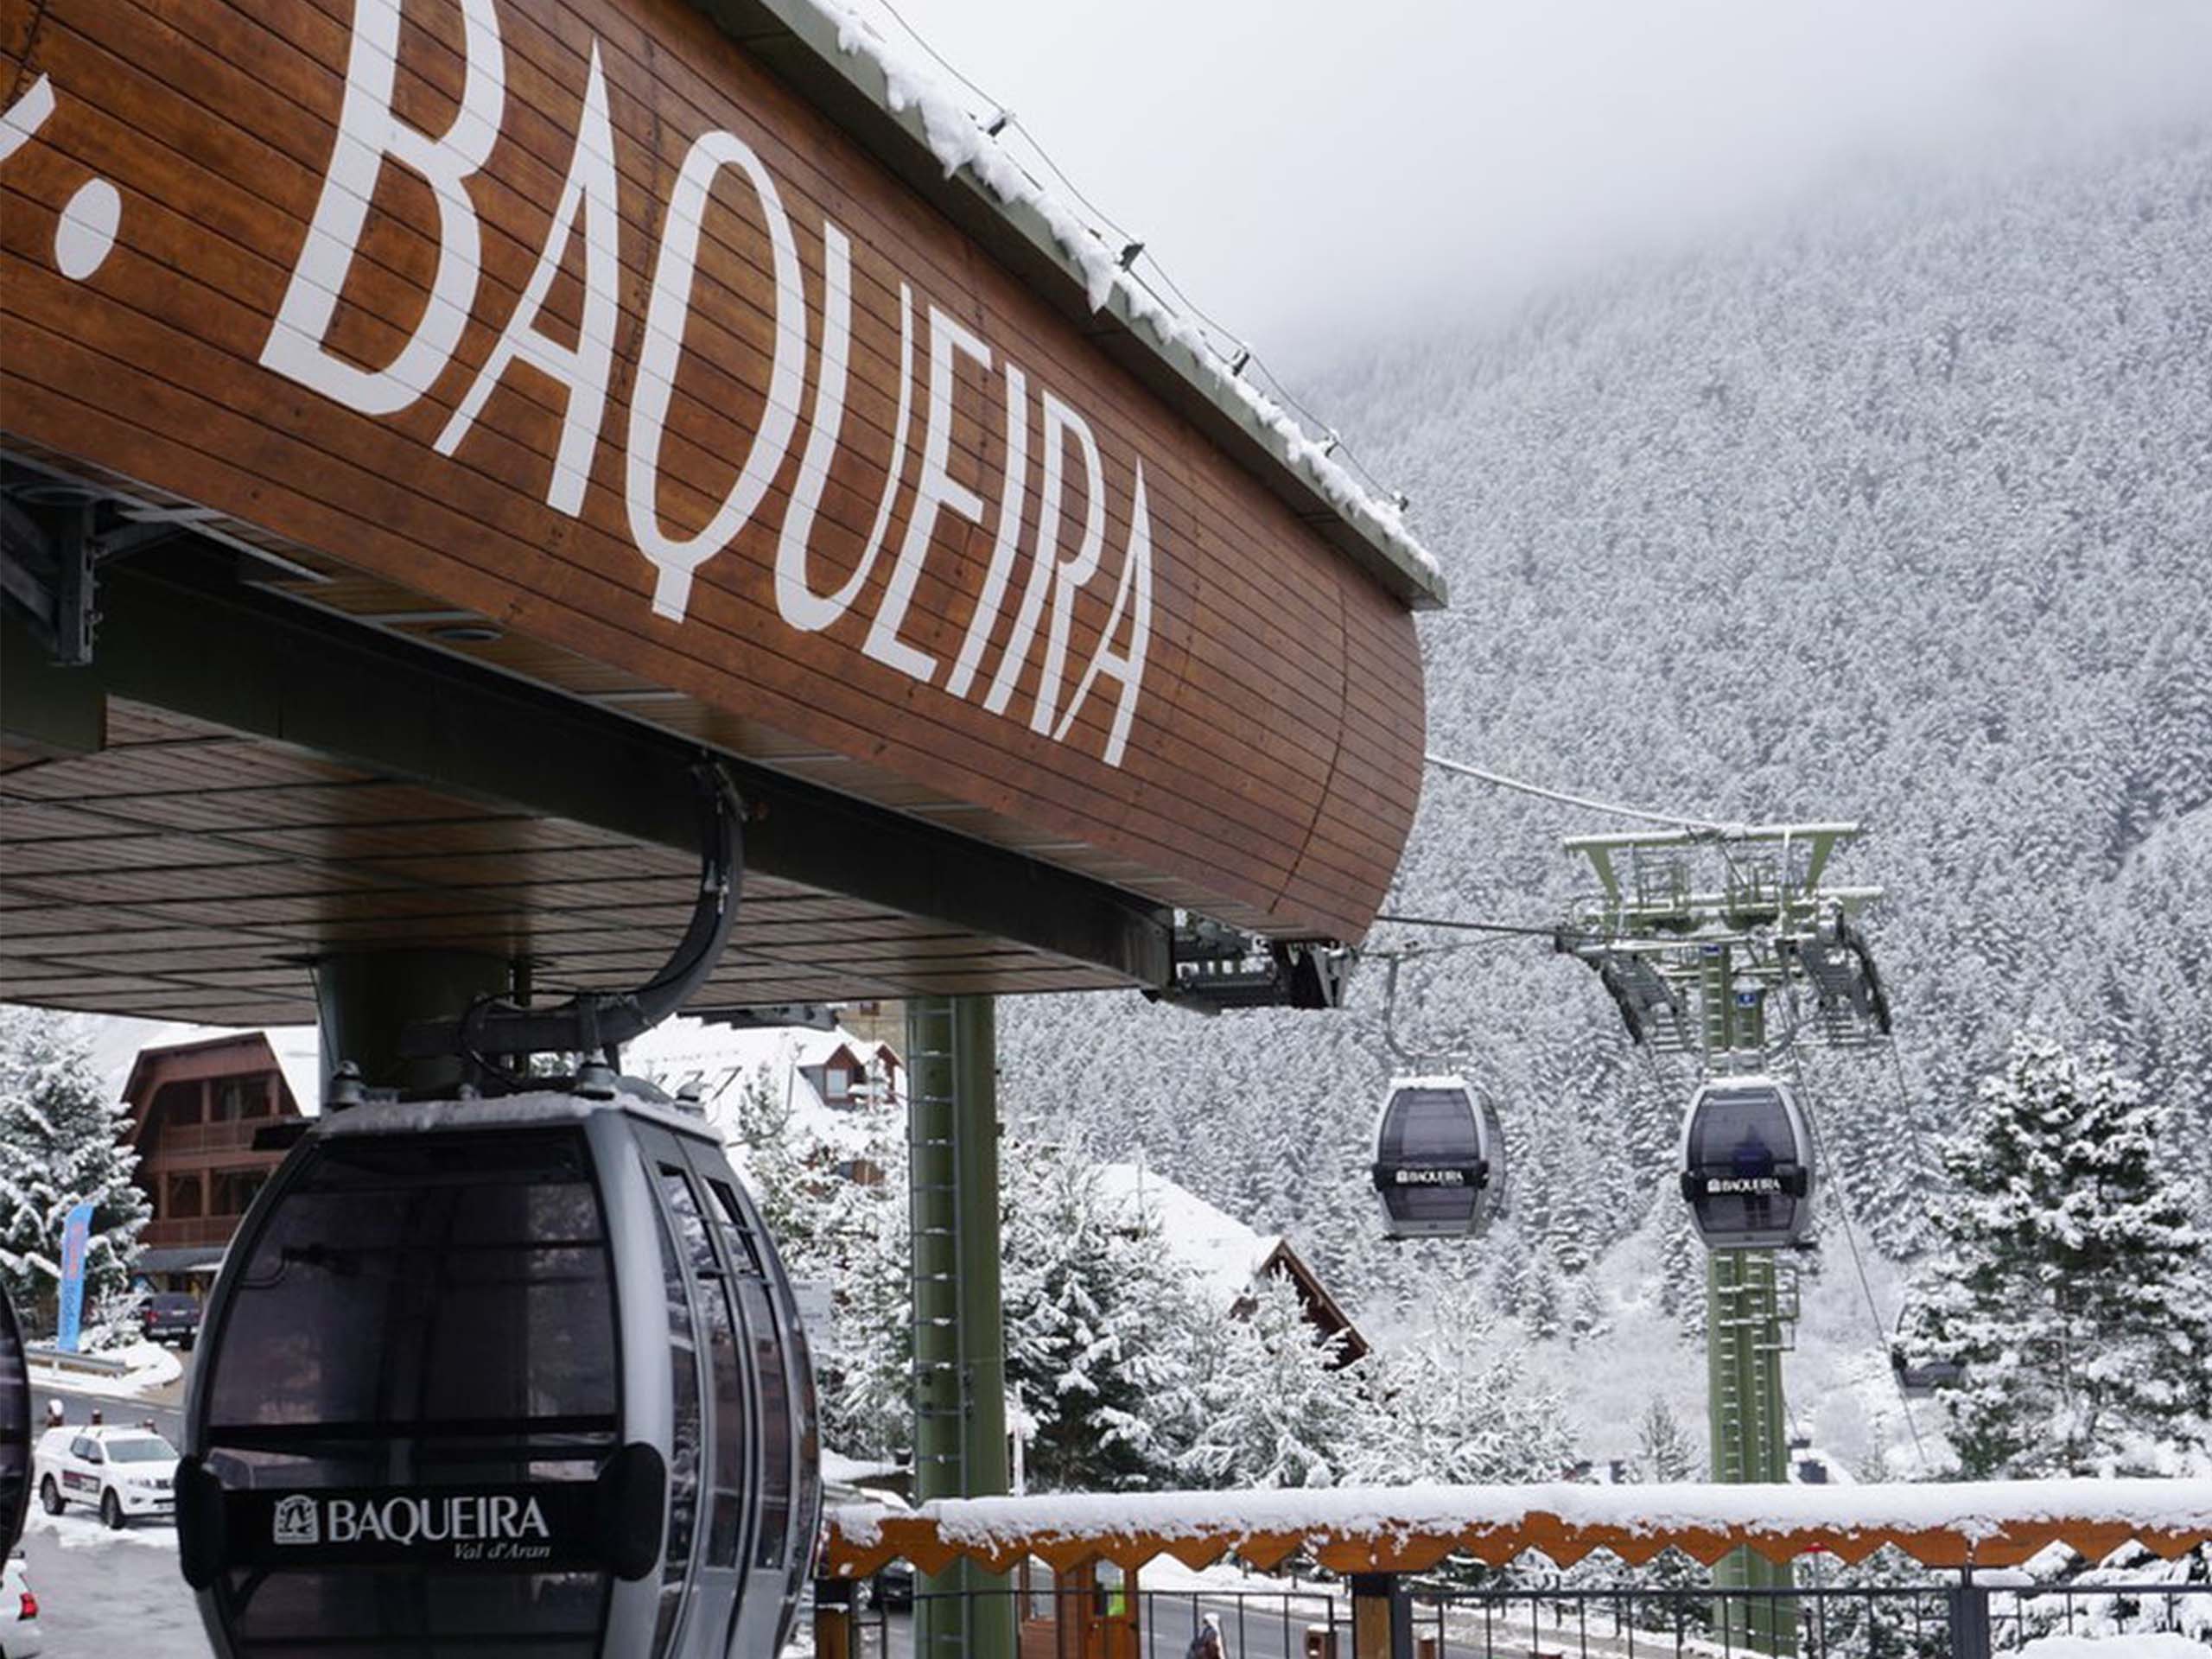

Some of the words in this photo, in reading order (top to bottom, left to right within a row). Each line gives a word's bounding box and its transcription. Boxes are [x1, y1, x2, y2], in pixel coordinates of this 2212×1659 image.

[259, 0, 1152, 767] BAQUEIRA
[1408, 1170, 1464, 1184] BAQUEIRA
[1721, 1178, 1780, 1192] BAQUEIRA
[327, 1496, 550, 1545] BAQUEIRA
[454, 1542, 484, 1559] Val
